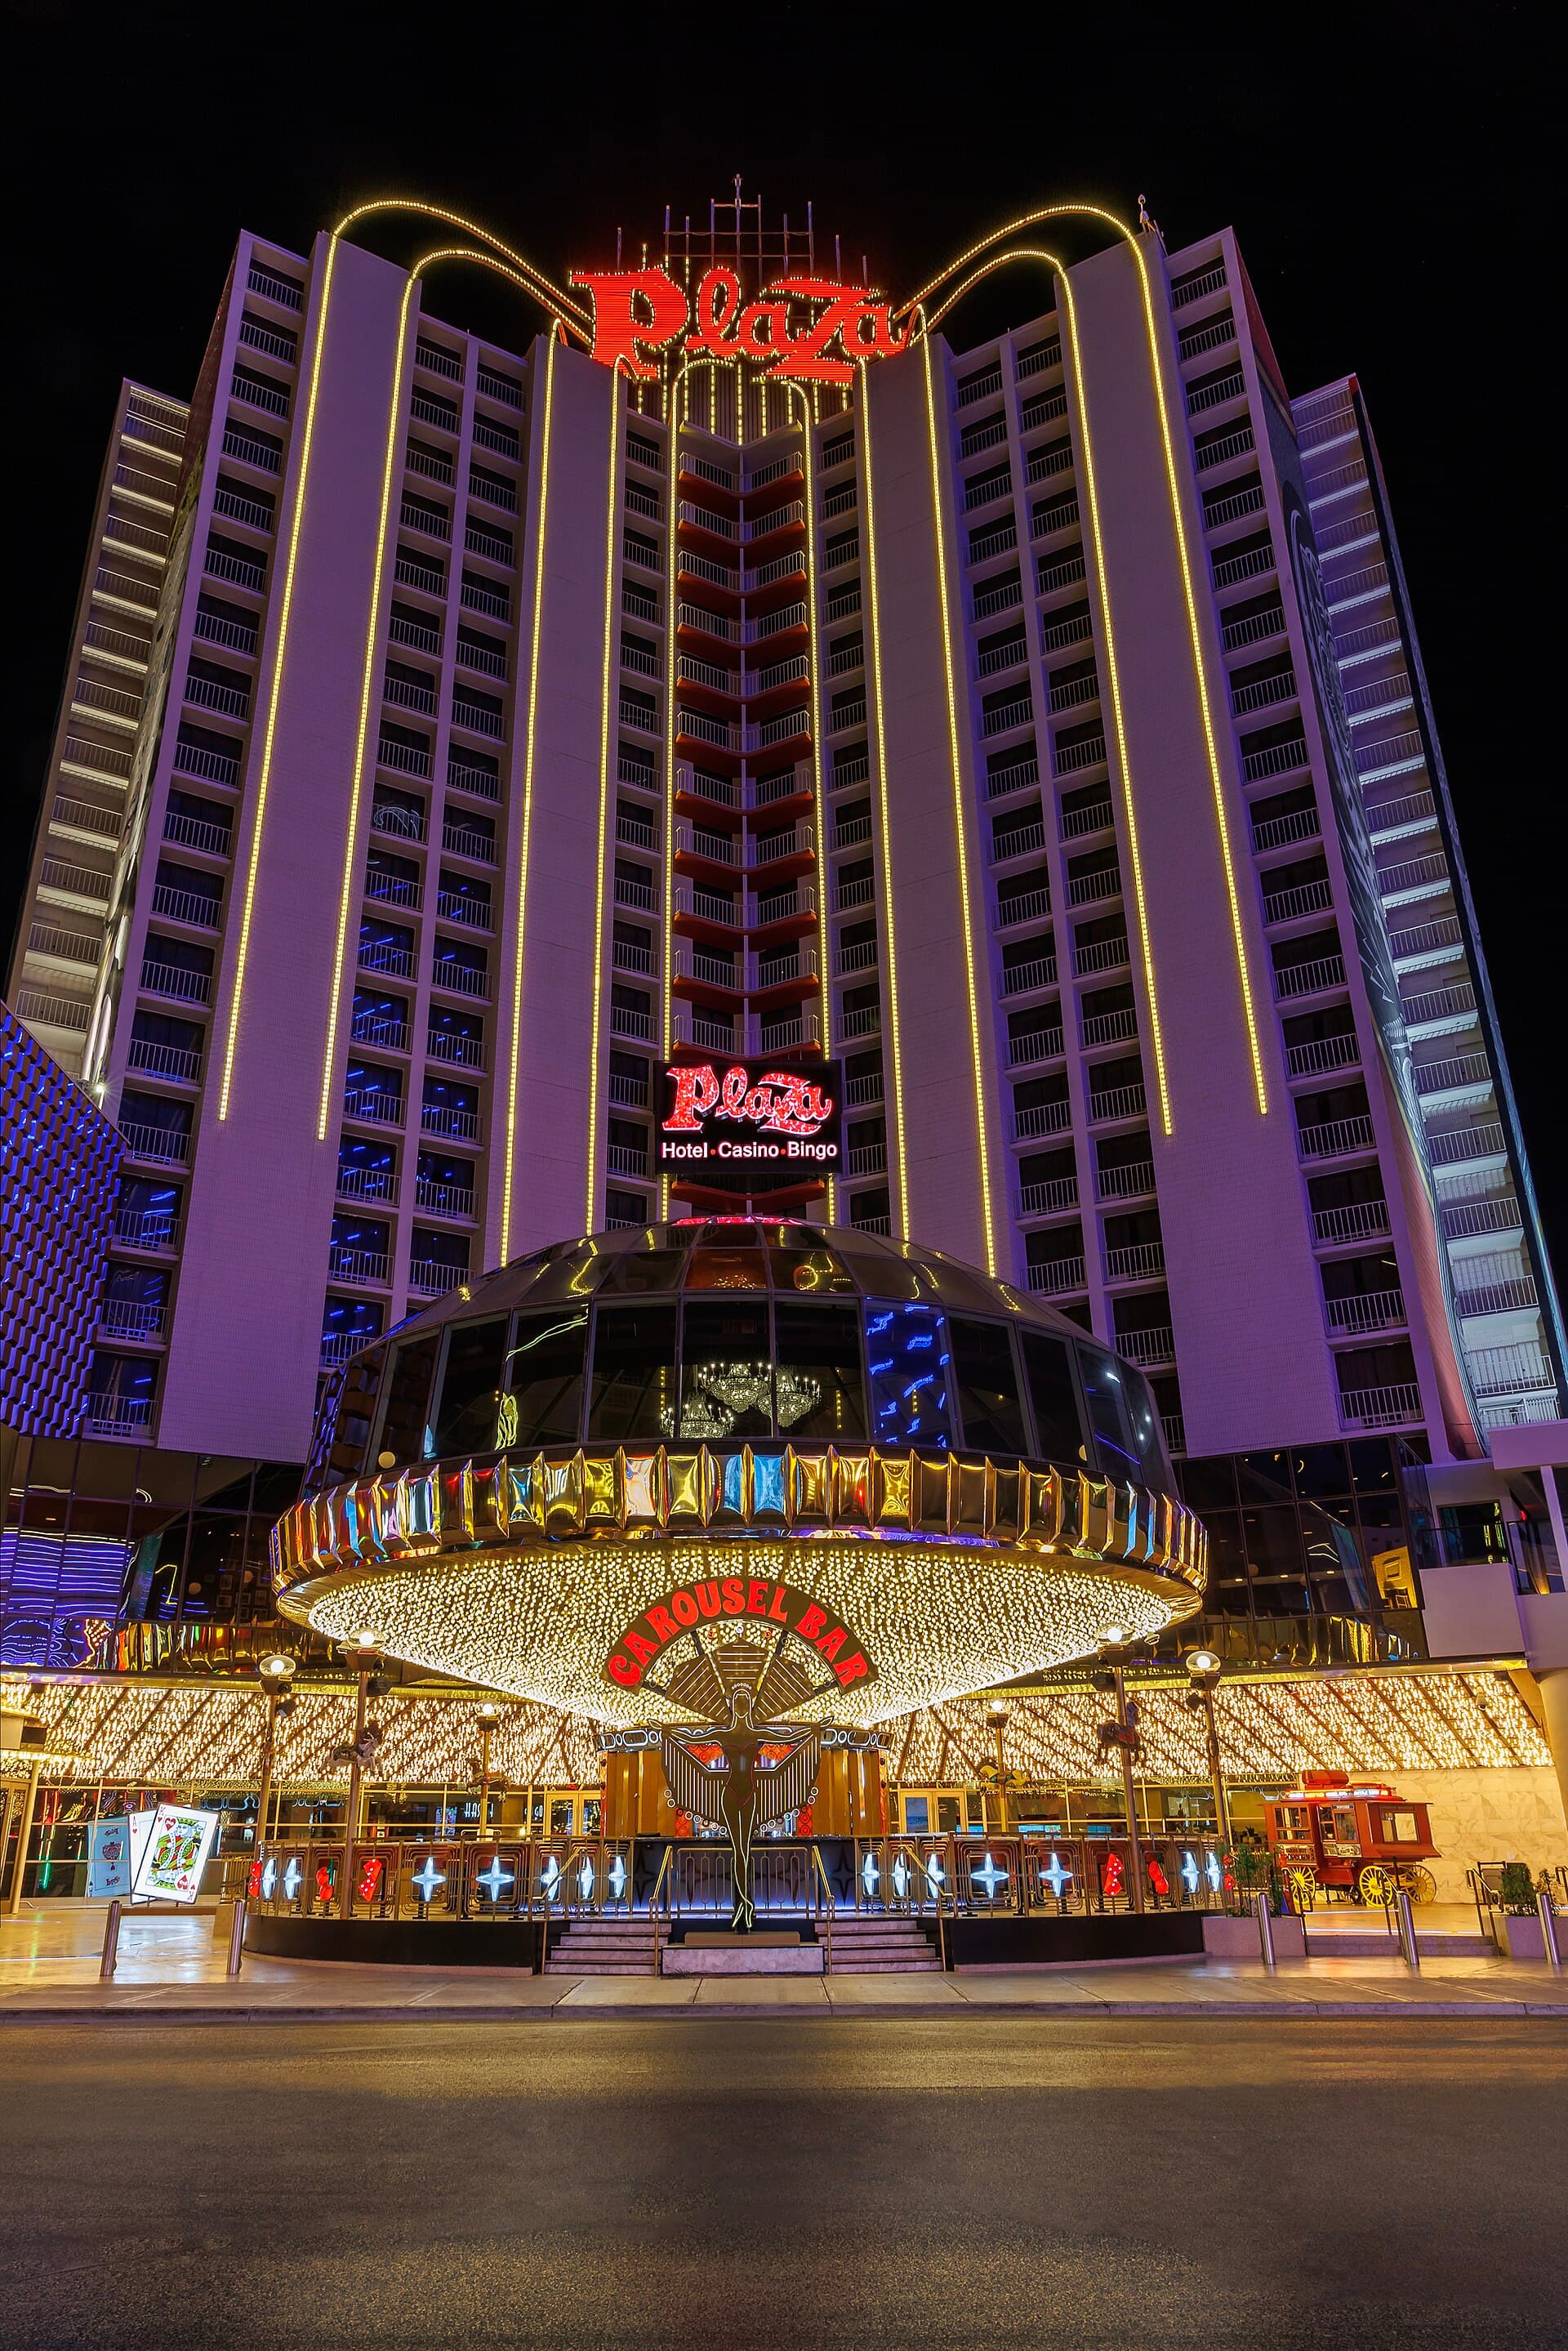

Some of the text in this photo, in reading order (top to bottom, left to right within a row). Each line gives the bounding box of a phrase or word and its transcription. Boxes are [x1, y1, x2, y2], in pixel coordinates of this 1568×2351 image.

[570, 265, 906, 386] Plaza
[662, 1064, 832, 1135] Plaza
[662, 1141, 838, 1160] Hotel Casino Bingo
[608, 1578, 869, 1688] CAROUSEL BAR
[132, 1816, 137, 1827] A
[158, 1806, 165, 1816] K
